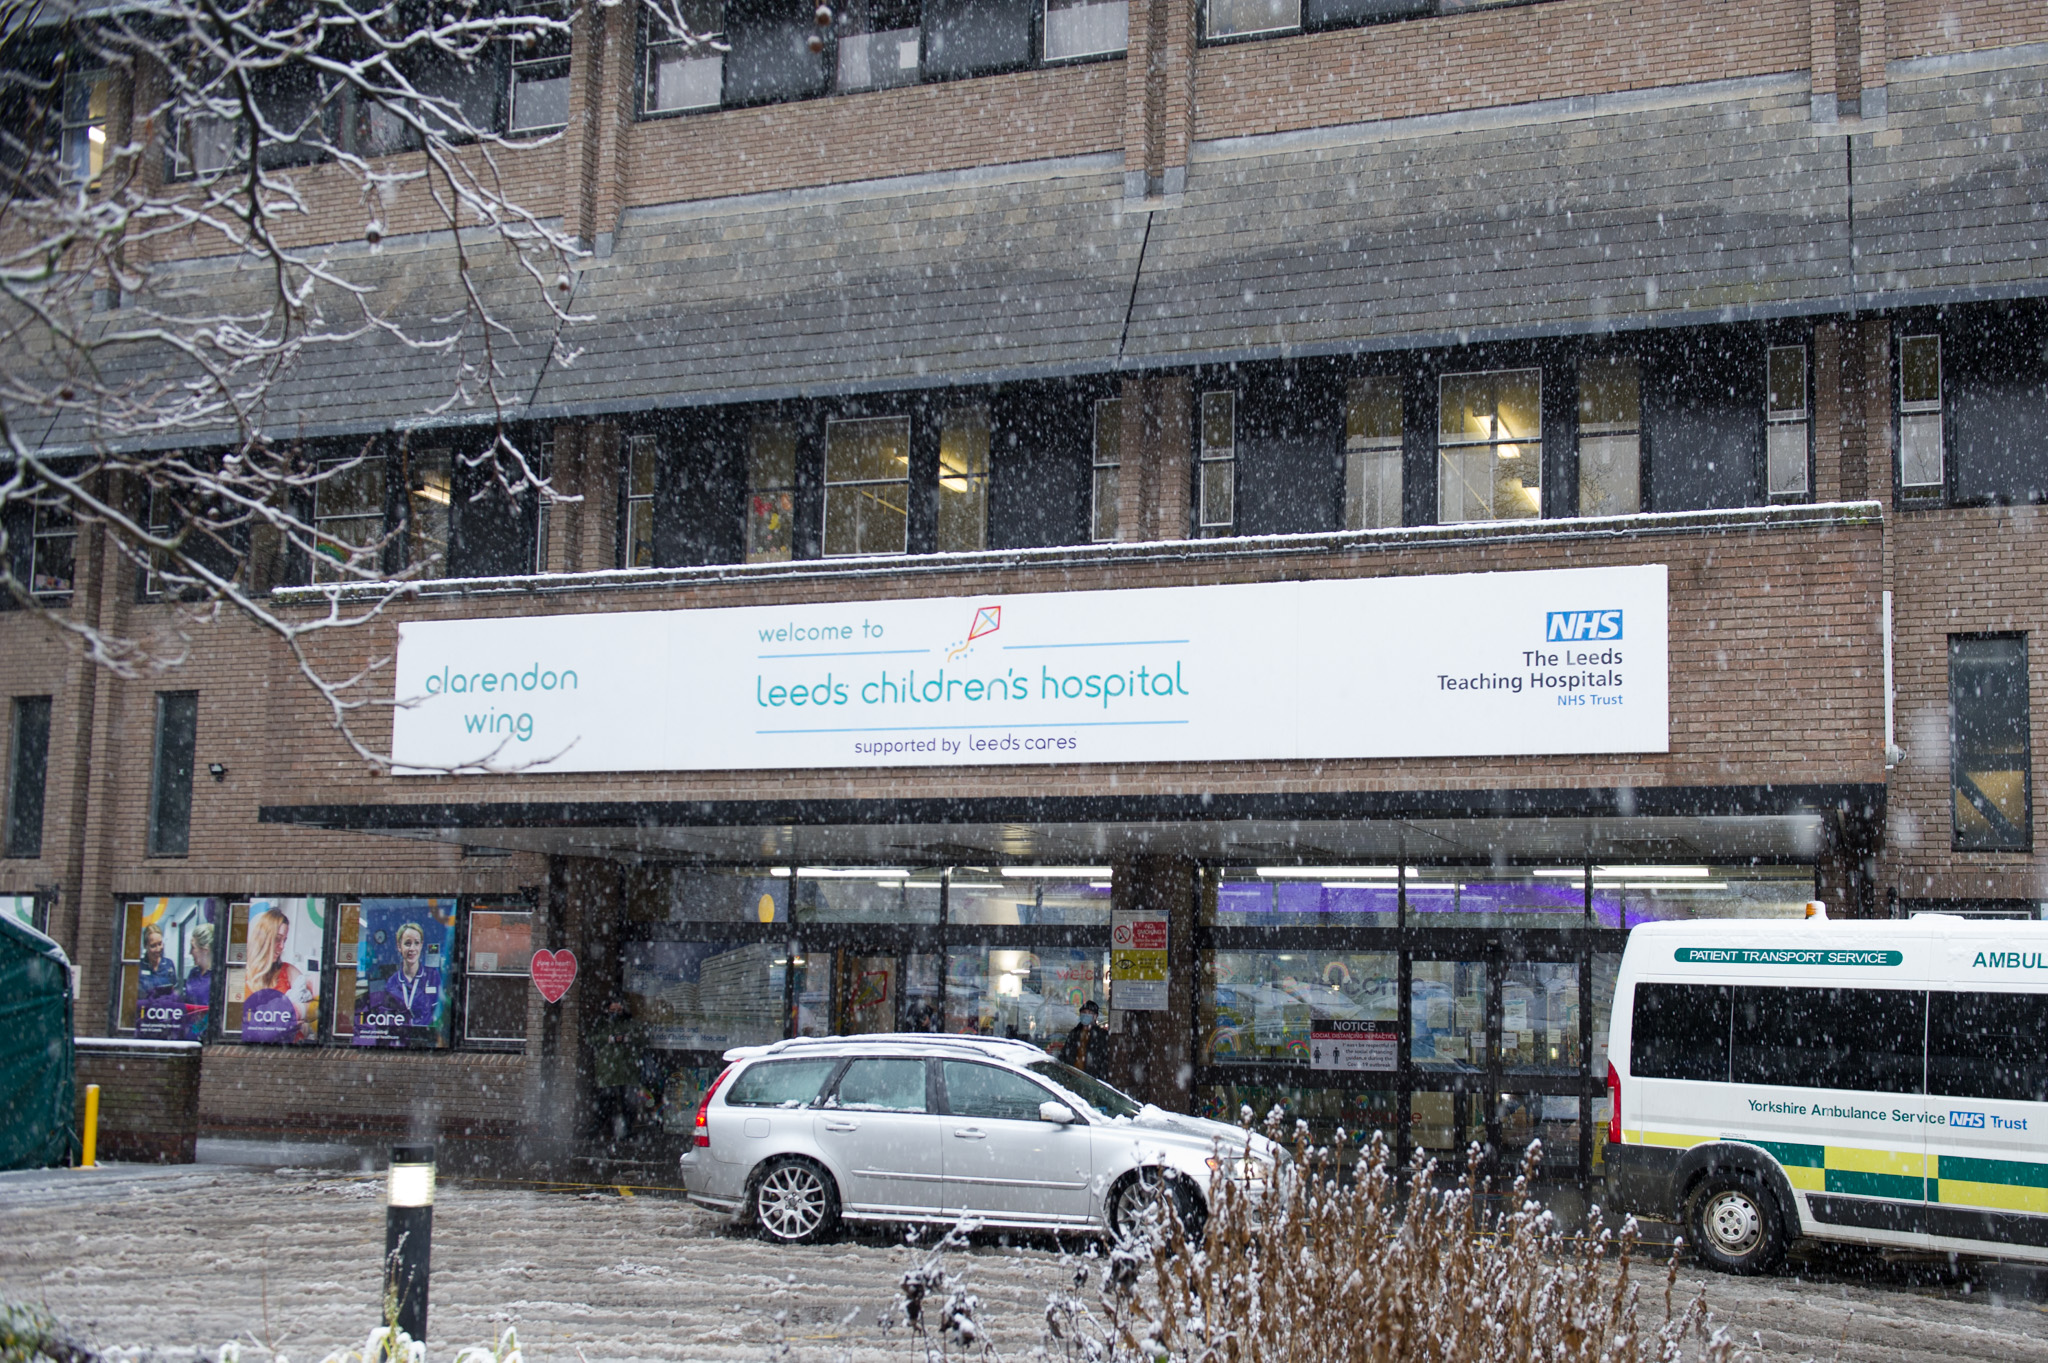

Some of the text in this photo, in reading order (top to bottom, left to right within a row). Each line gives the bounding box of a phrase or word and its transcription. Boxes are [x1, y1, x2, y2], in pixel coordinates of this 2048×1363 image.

[758, 619, 884, 642] welcome to
[1548, 612, 1621, 640] NHS
[1522, 648, 1623, 667] The Leeds
[426, 662, 578, 693] clarendon
[757, 660, 1189, 709] leeds children's hospital
[1437, 669, 1623, 693] Teaching Hospitals
[1557, 694, 1624, 706] NHS Trust
[464, 706, 533, 742] wing
[855, 733, 1077, 756] supported by leeds cares
[1689, 950, 1887, 964] PATIENT TRANSPORT SERVICE
[147, 1008, 183, 1020] care
[254, 1010, 291, 1023] care
[366, 1013, 405, 1026] care
[1333, 1021, 1376, 1032] NOTICE
[1748, 1099, 2028, 1131] Yorkshire Ambulance Service NHS Trust
